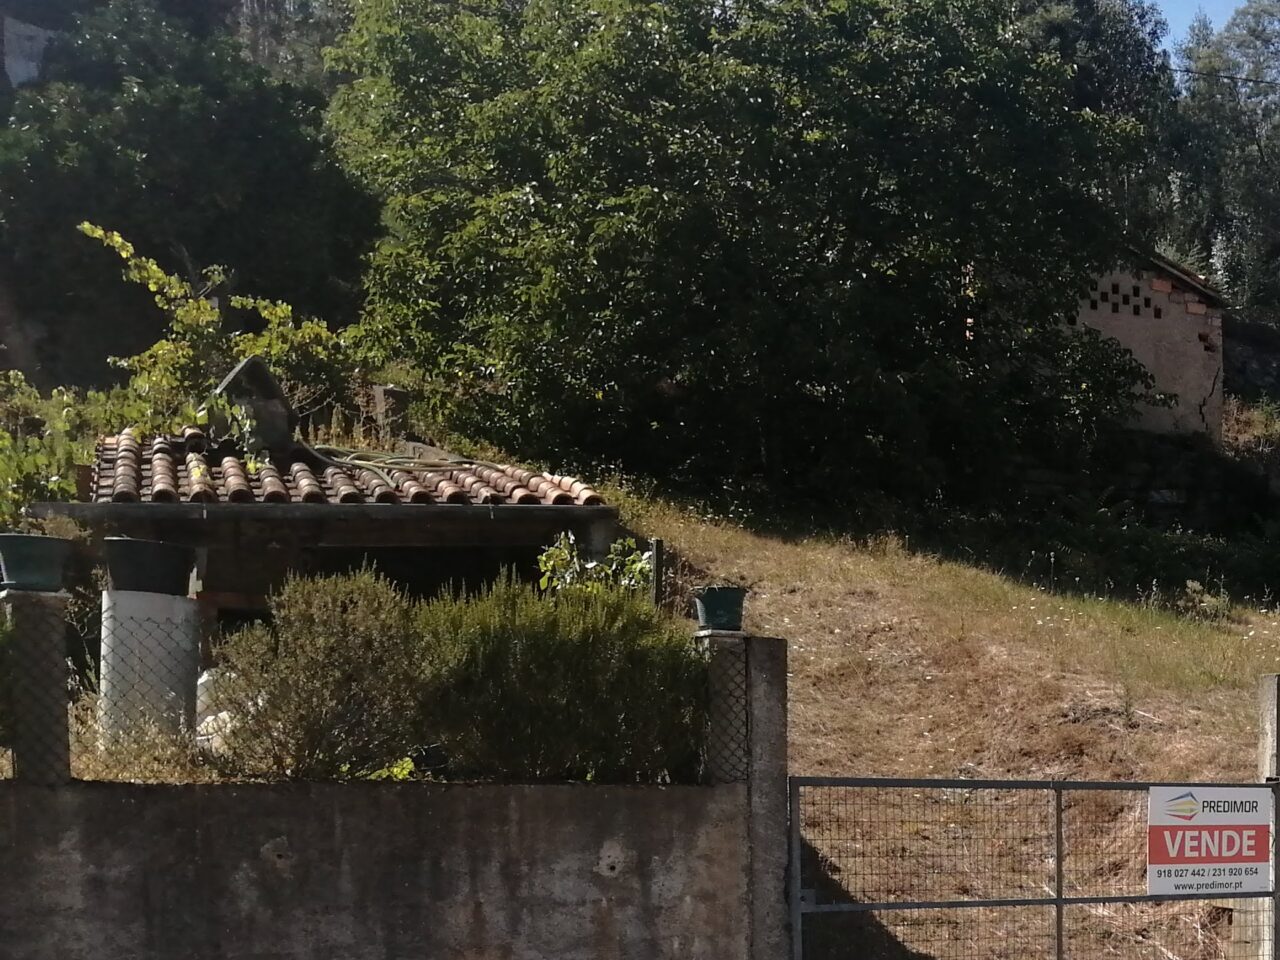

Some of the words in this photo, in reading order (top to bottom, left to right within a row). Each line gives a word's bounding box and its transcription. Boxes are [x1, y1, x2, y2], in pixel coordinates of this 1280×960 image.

[1202, 800, 1258, 813] PREDIMOR
[1163, 830, 1256, 858] VENDE
[1157, 869, 1171, 878] 918
[1174, 869, 1188, 877] 027
[1191, 869, 1205, 877] 442
[1212, 868, 1226, 876] 231
[1228, 868, 1242, 876] 920
[1174, 880, 1242, 891] www.predimor.pt
